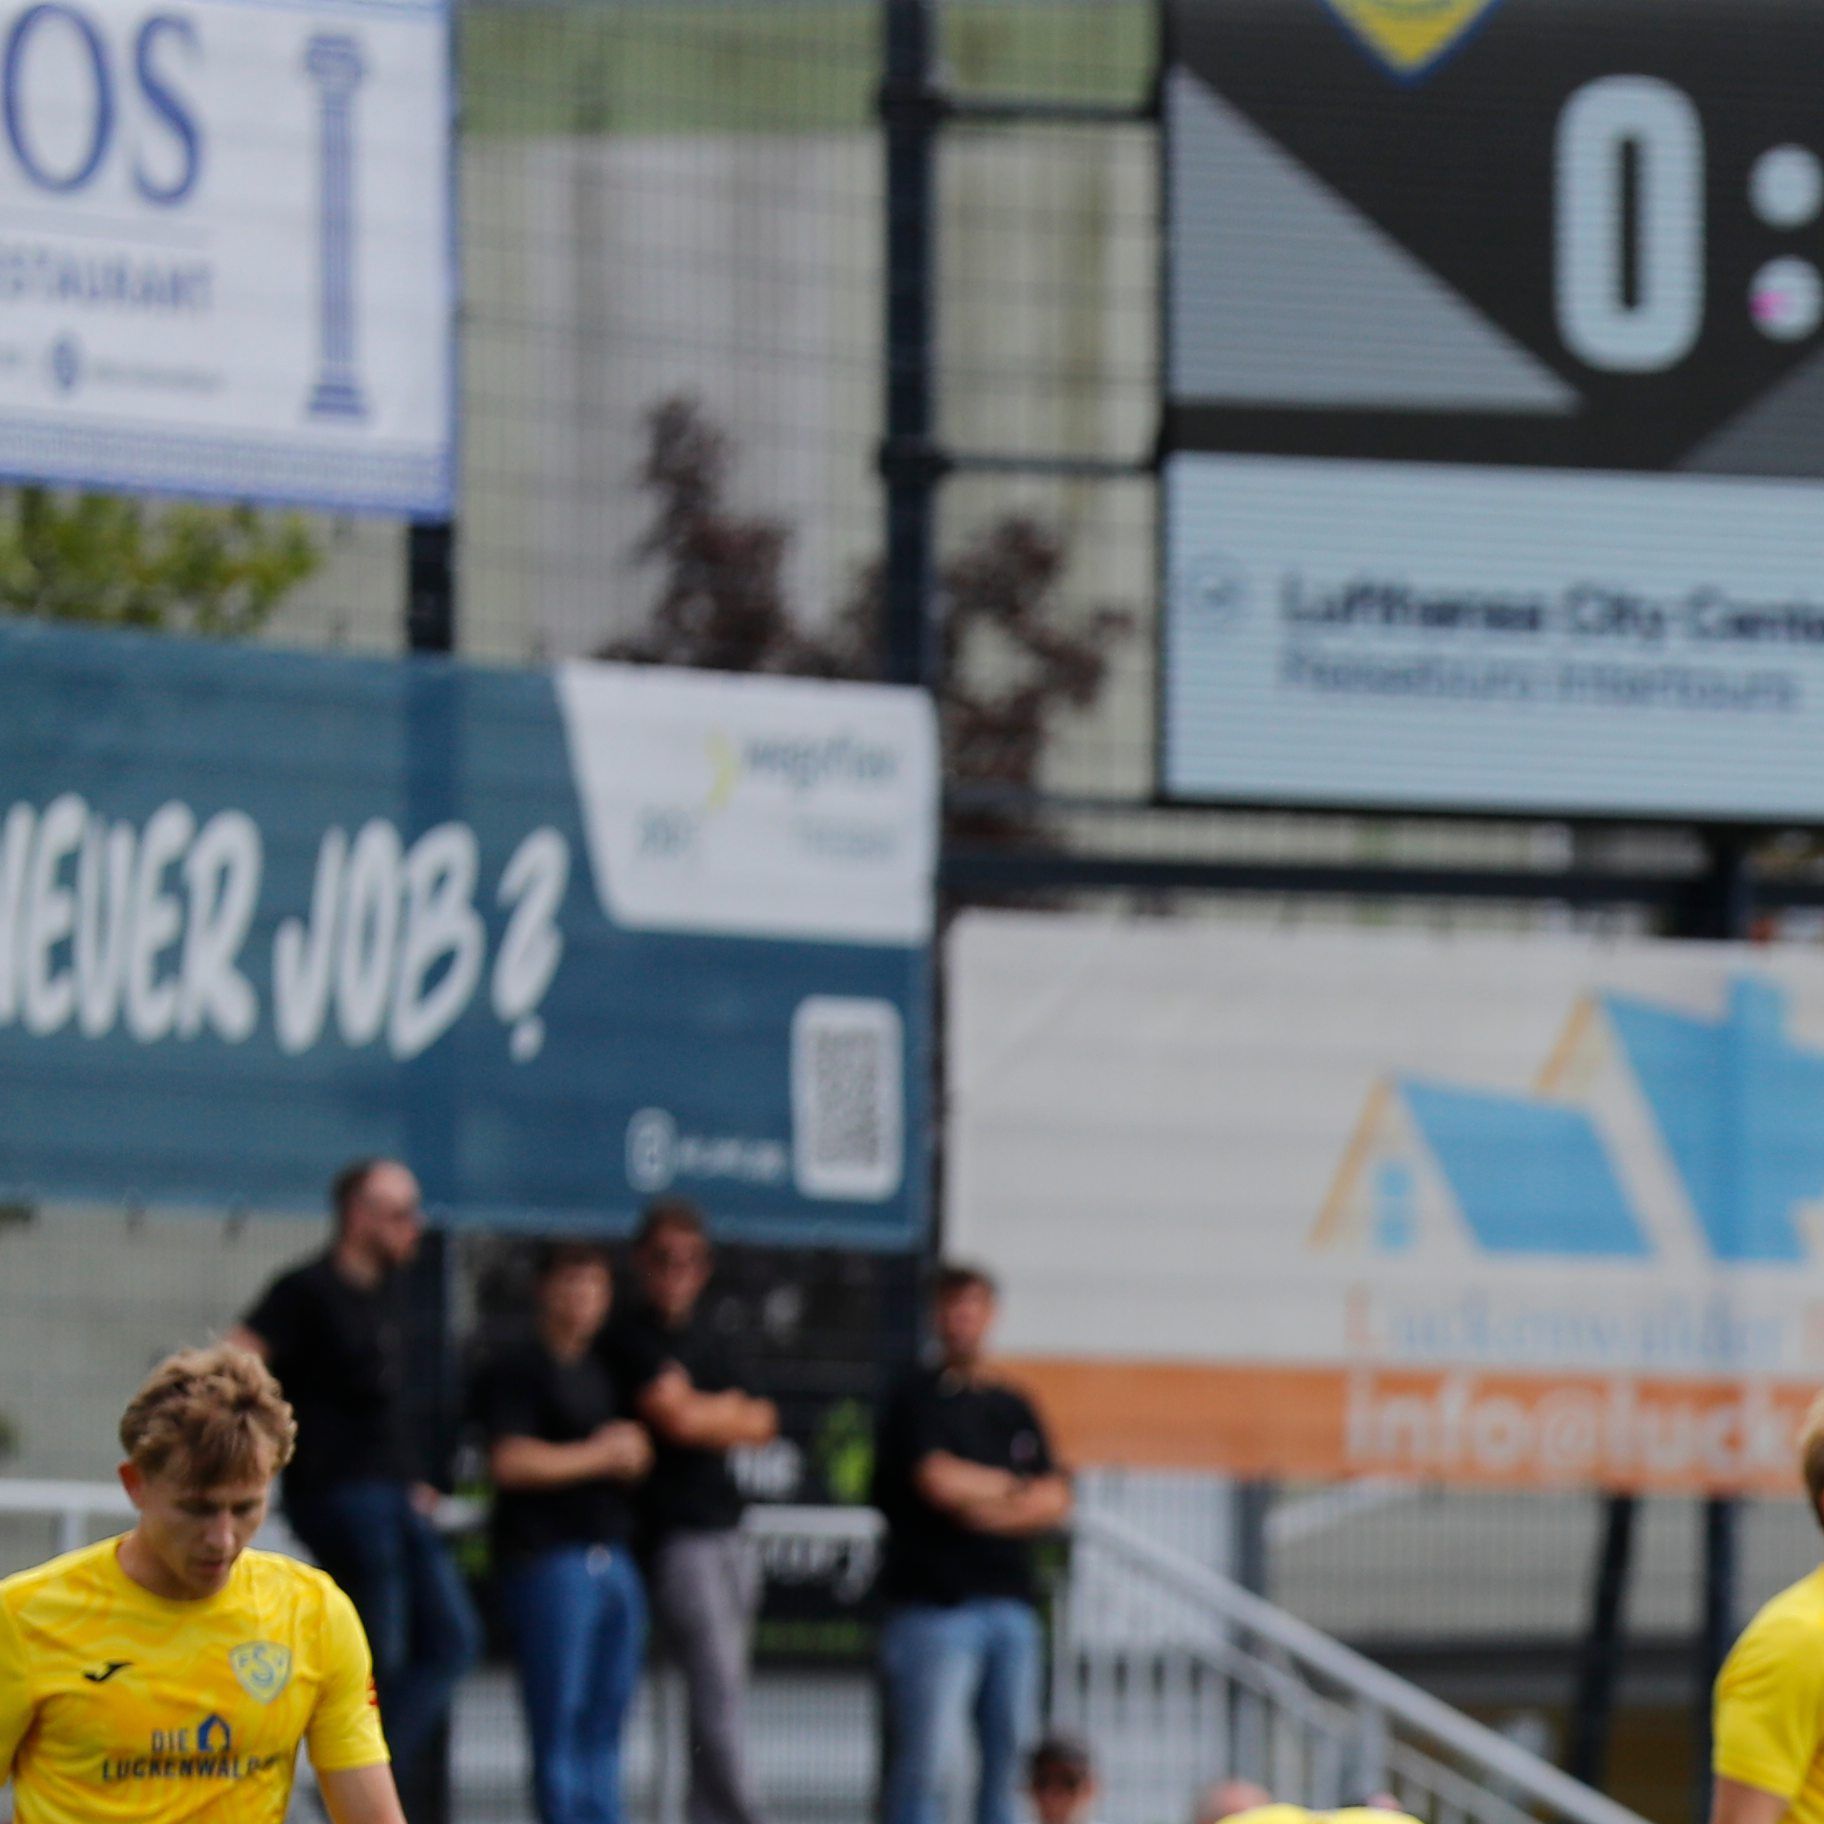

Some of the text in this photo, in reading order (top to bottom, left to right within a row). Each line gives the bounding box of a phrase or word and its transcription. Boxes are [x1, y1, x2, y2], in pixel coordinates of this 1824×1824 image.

[0, 245, 214, 314] STAURANT
[1284, 575, 1541, 633] Lufthansa
[1565, 580, 1667, 644] City
[272, 817, 571, 1063] JOB?
[152, 1729, 187, 1752] DIE
